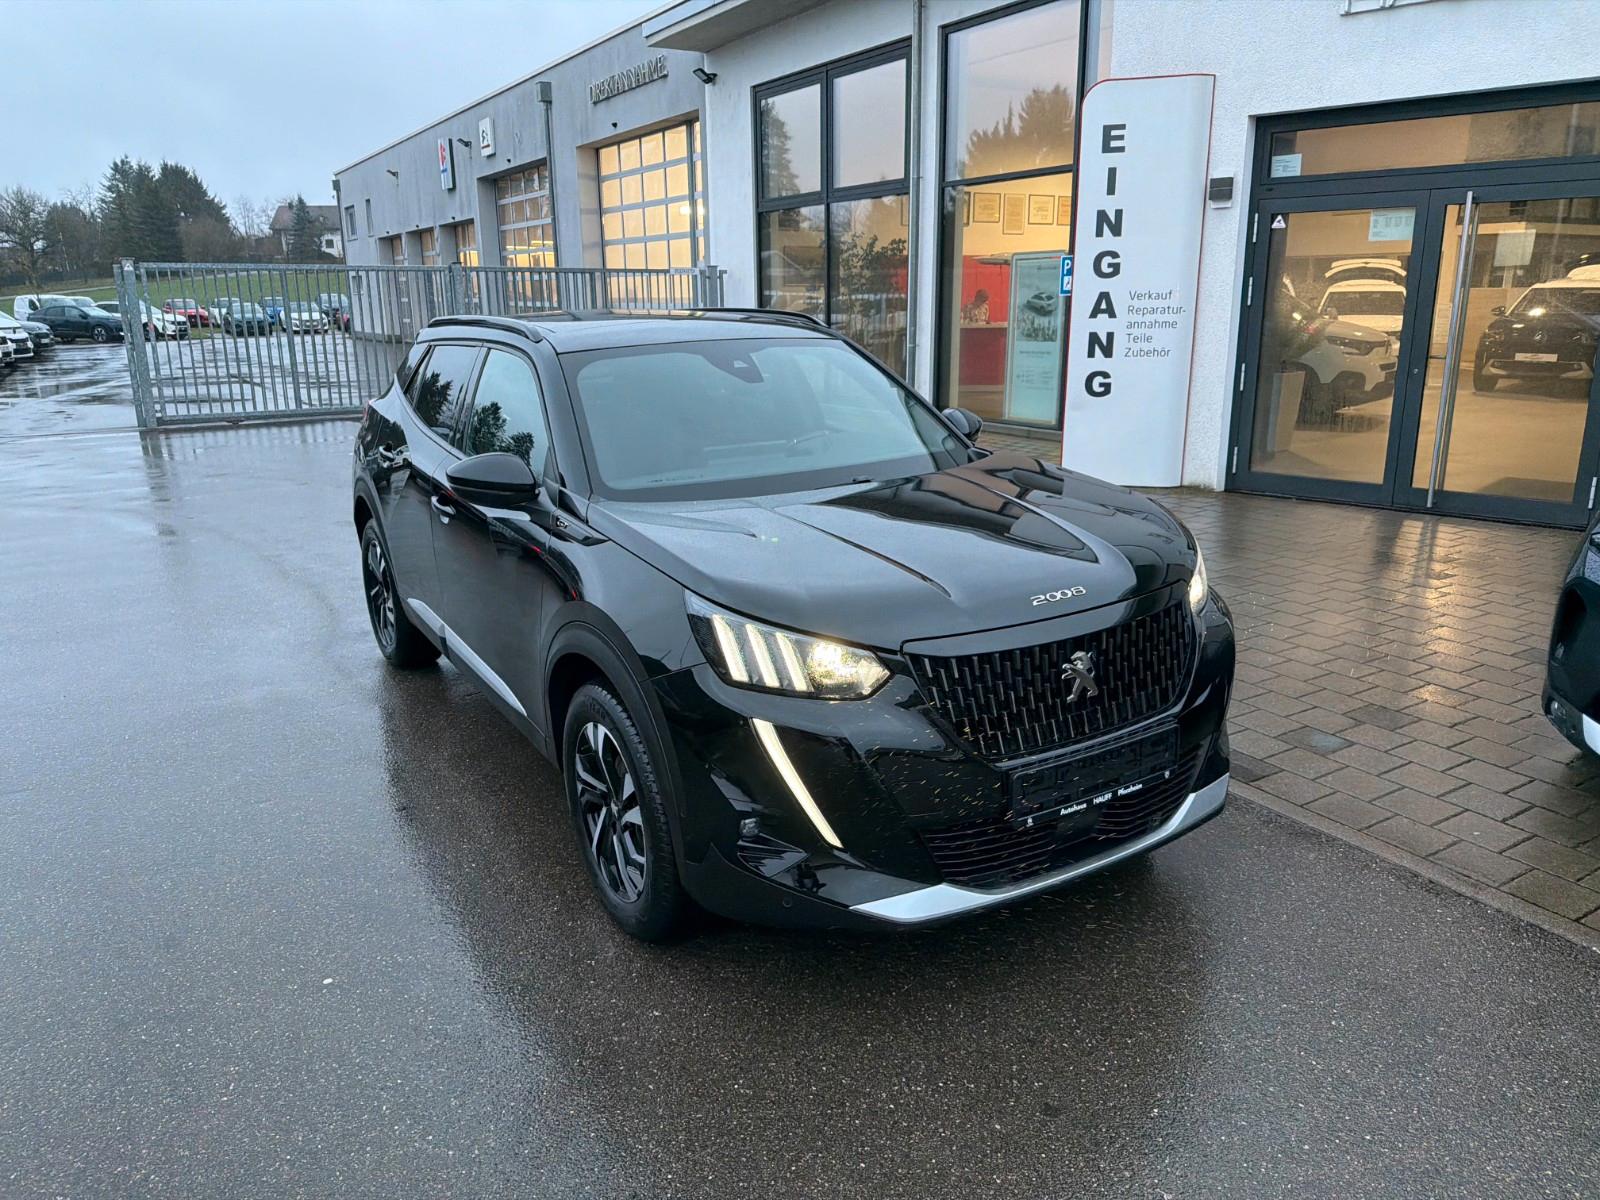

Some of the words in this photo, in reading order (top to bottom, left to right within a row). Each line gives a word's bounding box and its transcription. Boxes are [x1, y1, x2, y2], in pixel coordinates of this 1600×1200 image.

[589, 54, 668, 105] DIREKTANNAHME
[1084, 123, 1127, 397] EINGANG
[1129, 289, 1172, 301] Verkauf
[1127, 305, 1187, 317] Reparatur-
[1126, 319, 1178, 329] annahme
[1126, 333, 1153, 343] Teile
[1124, 347, 1171, 358] Zubehör
[1030, 586, 1086, 606] 2008
[1060, 802, 1087, 816] Autohaus
